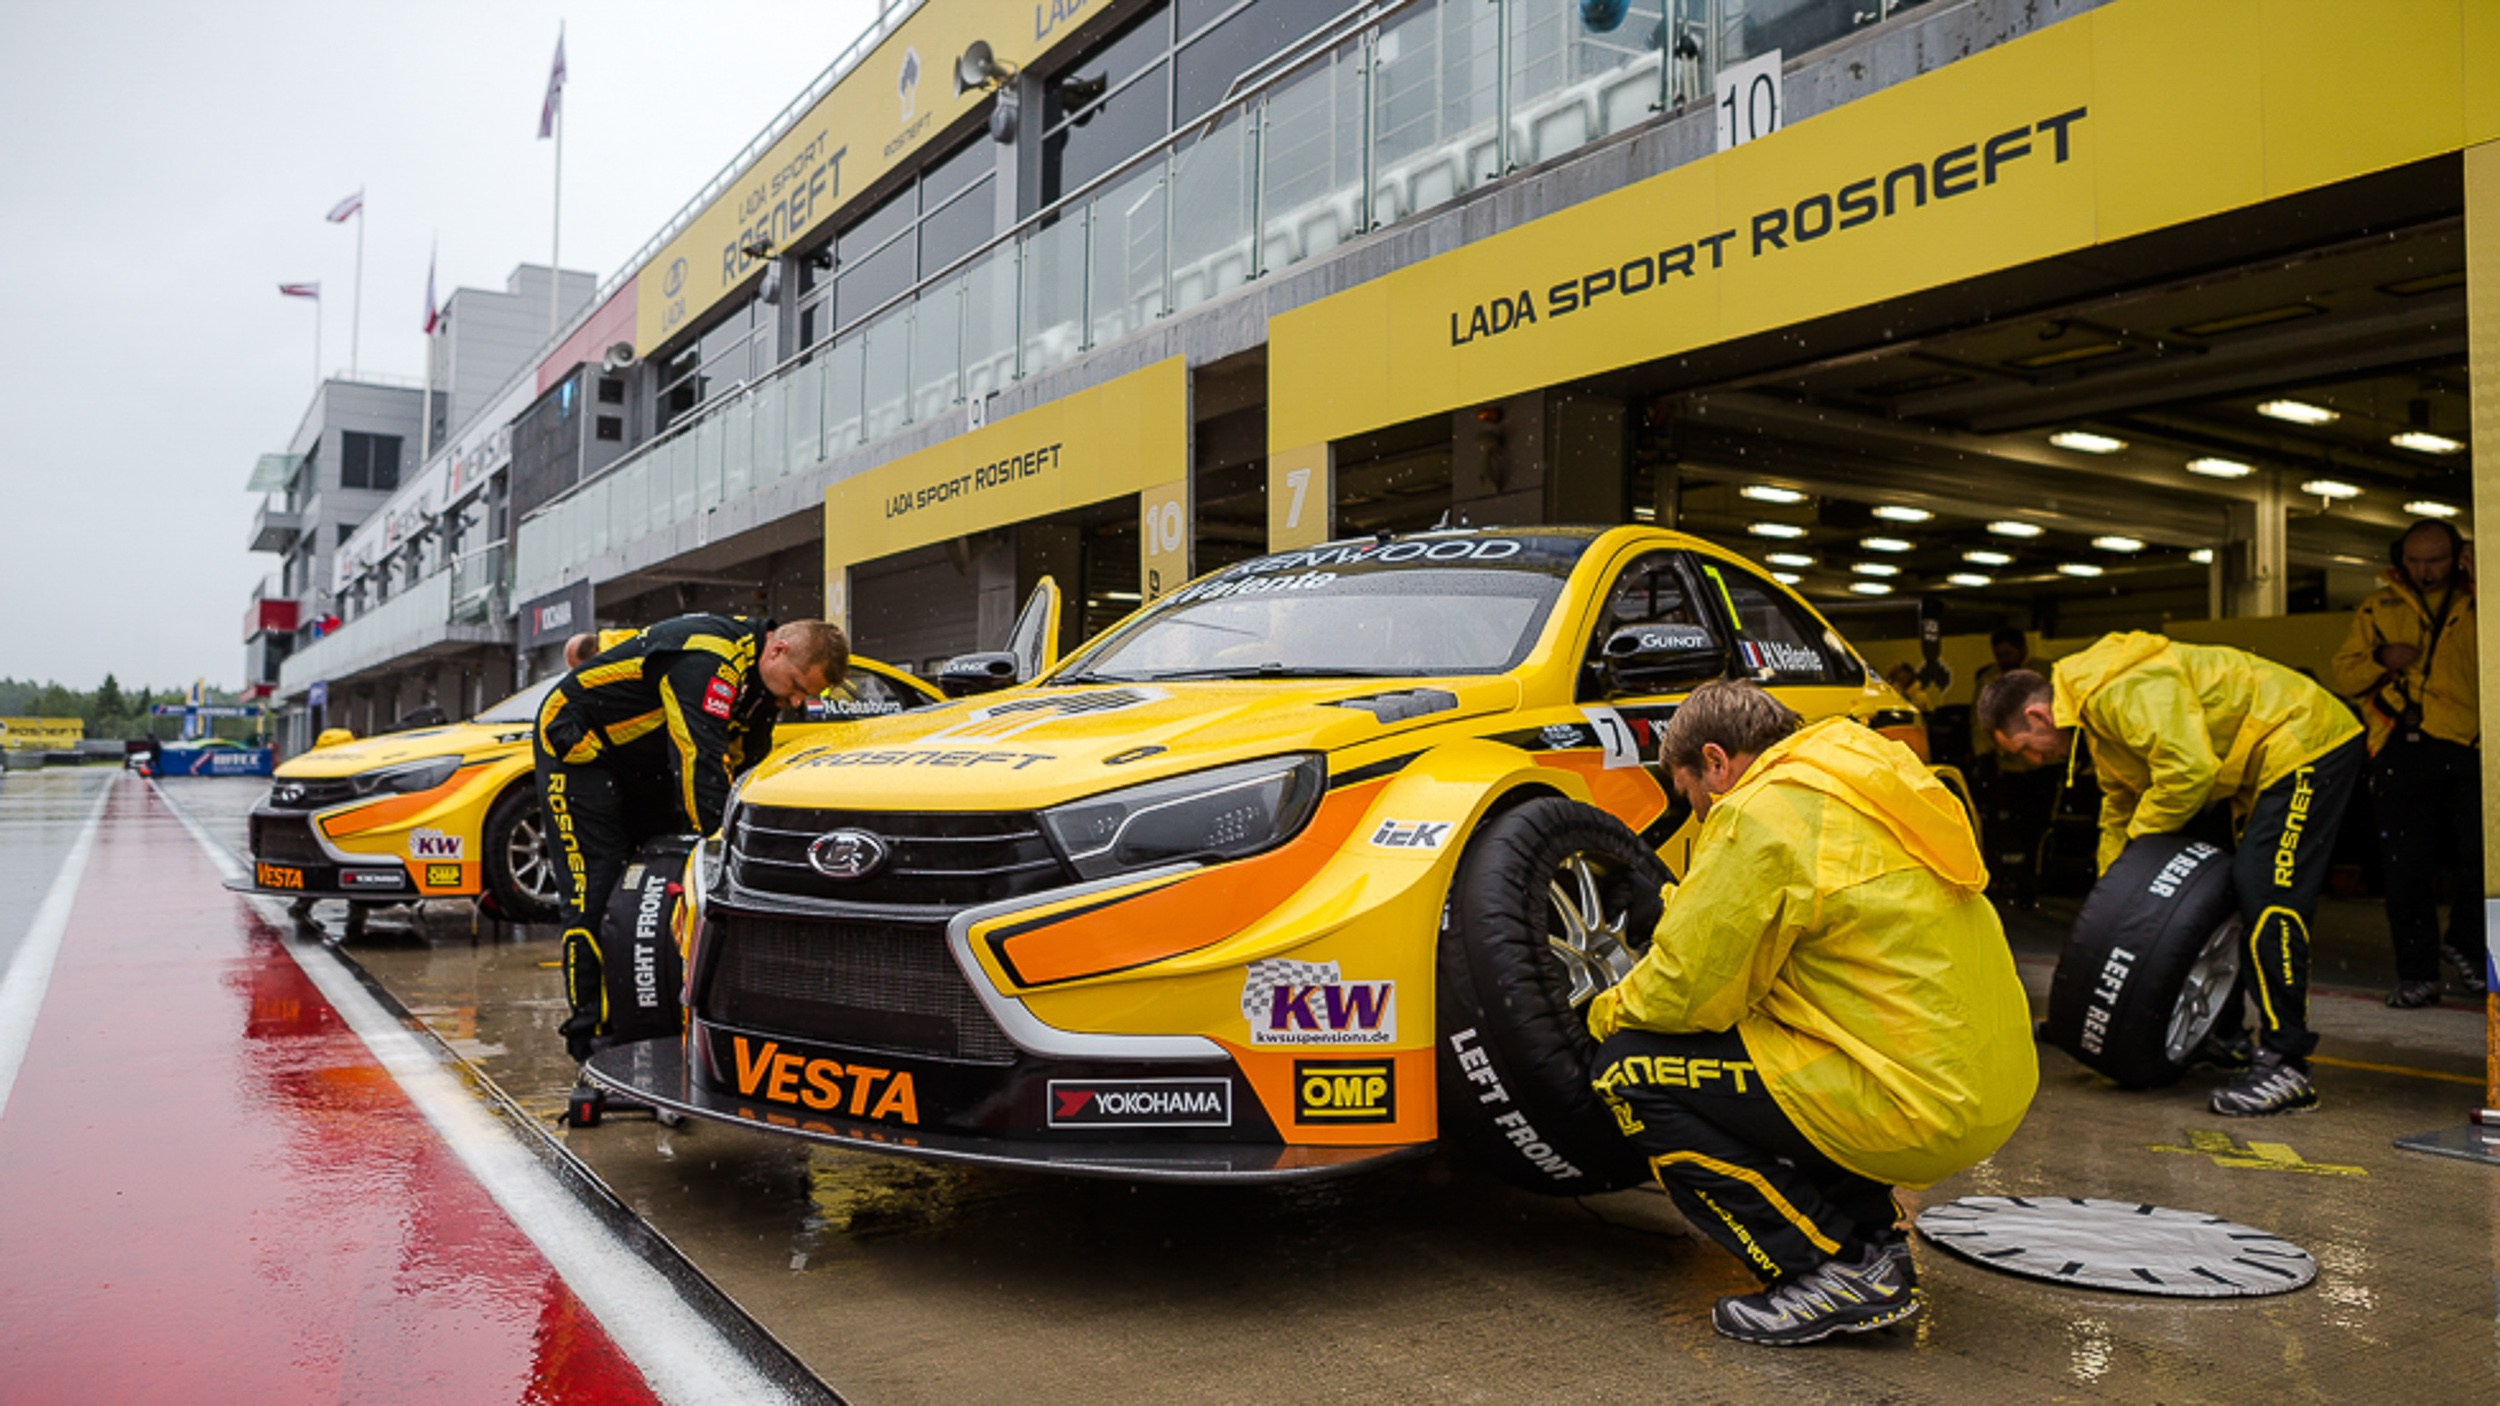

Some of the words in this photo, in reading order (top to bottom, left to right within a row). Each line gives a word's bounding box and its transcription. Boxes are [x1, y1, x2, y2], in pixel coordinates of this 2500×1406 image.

[1721, 72, 1778, 147] 10
[770, 129, 829, 199] SPORT
[1450, 289, 1537, 347] LADA
[1548, 229, 1736, 318] SPORT
[1751, 106, 2089, 258] ROSNEFT
[885, 491, 915, 519] LADA
[916, 474, 972, 511] SPORT
[975, 442, 1063, 492] ROSNEFT
[1285, 468, 1312, 529] 7
[1145, 499, 1184, 557] 10
[1641, 633, 1703, 648] GUINOT
[794, 750, 1056, 770] ROSNEFT
[1598, 717, 1623, 757] 7
[417, 836, 461, 855] KW
[547, 772, 588, 914] ROSNEFT
[2273, 766, 2316, 888] ROSNEFT
[256, 862, 304, 890] VESTA
[2148, 851, 2199, 898] REAR
[635, 875, 667, 939] FRONT
[634, 943, 660, 1008] RIGHT
[2094, 946, 2137, 1005] LEFT
[1256, 1031, 1390, 1043] kwsuspensions.de
[1270, 983, 1393, 1032] KW
[733, 1036, 920, 1125] VESTA
[1094, 1092, 1222, 1114] YOKOHAMA
[1302, 1076, 1388, 1108] OMP
[1449, 1027, 1510, 1104] LEFT
[1494, 1109, 1583, 1181] FRONT
